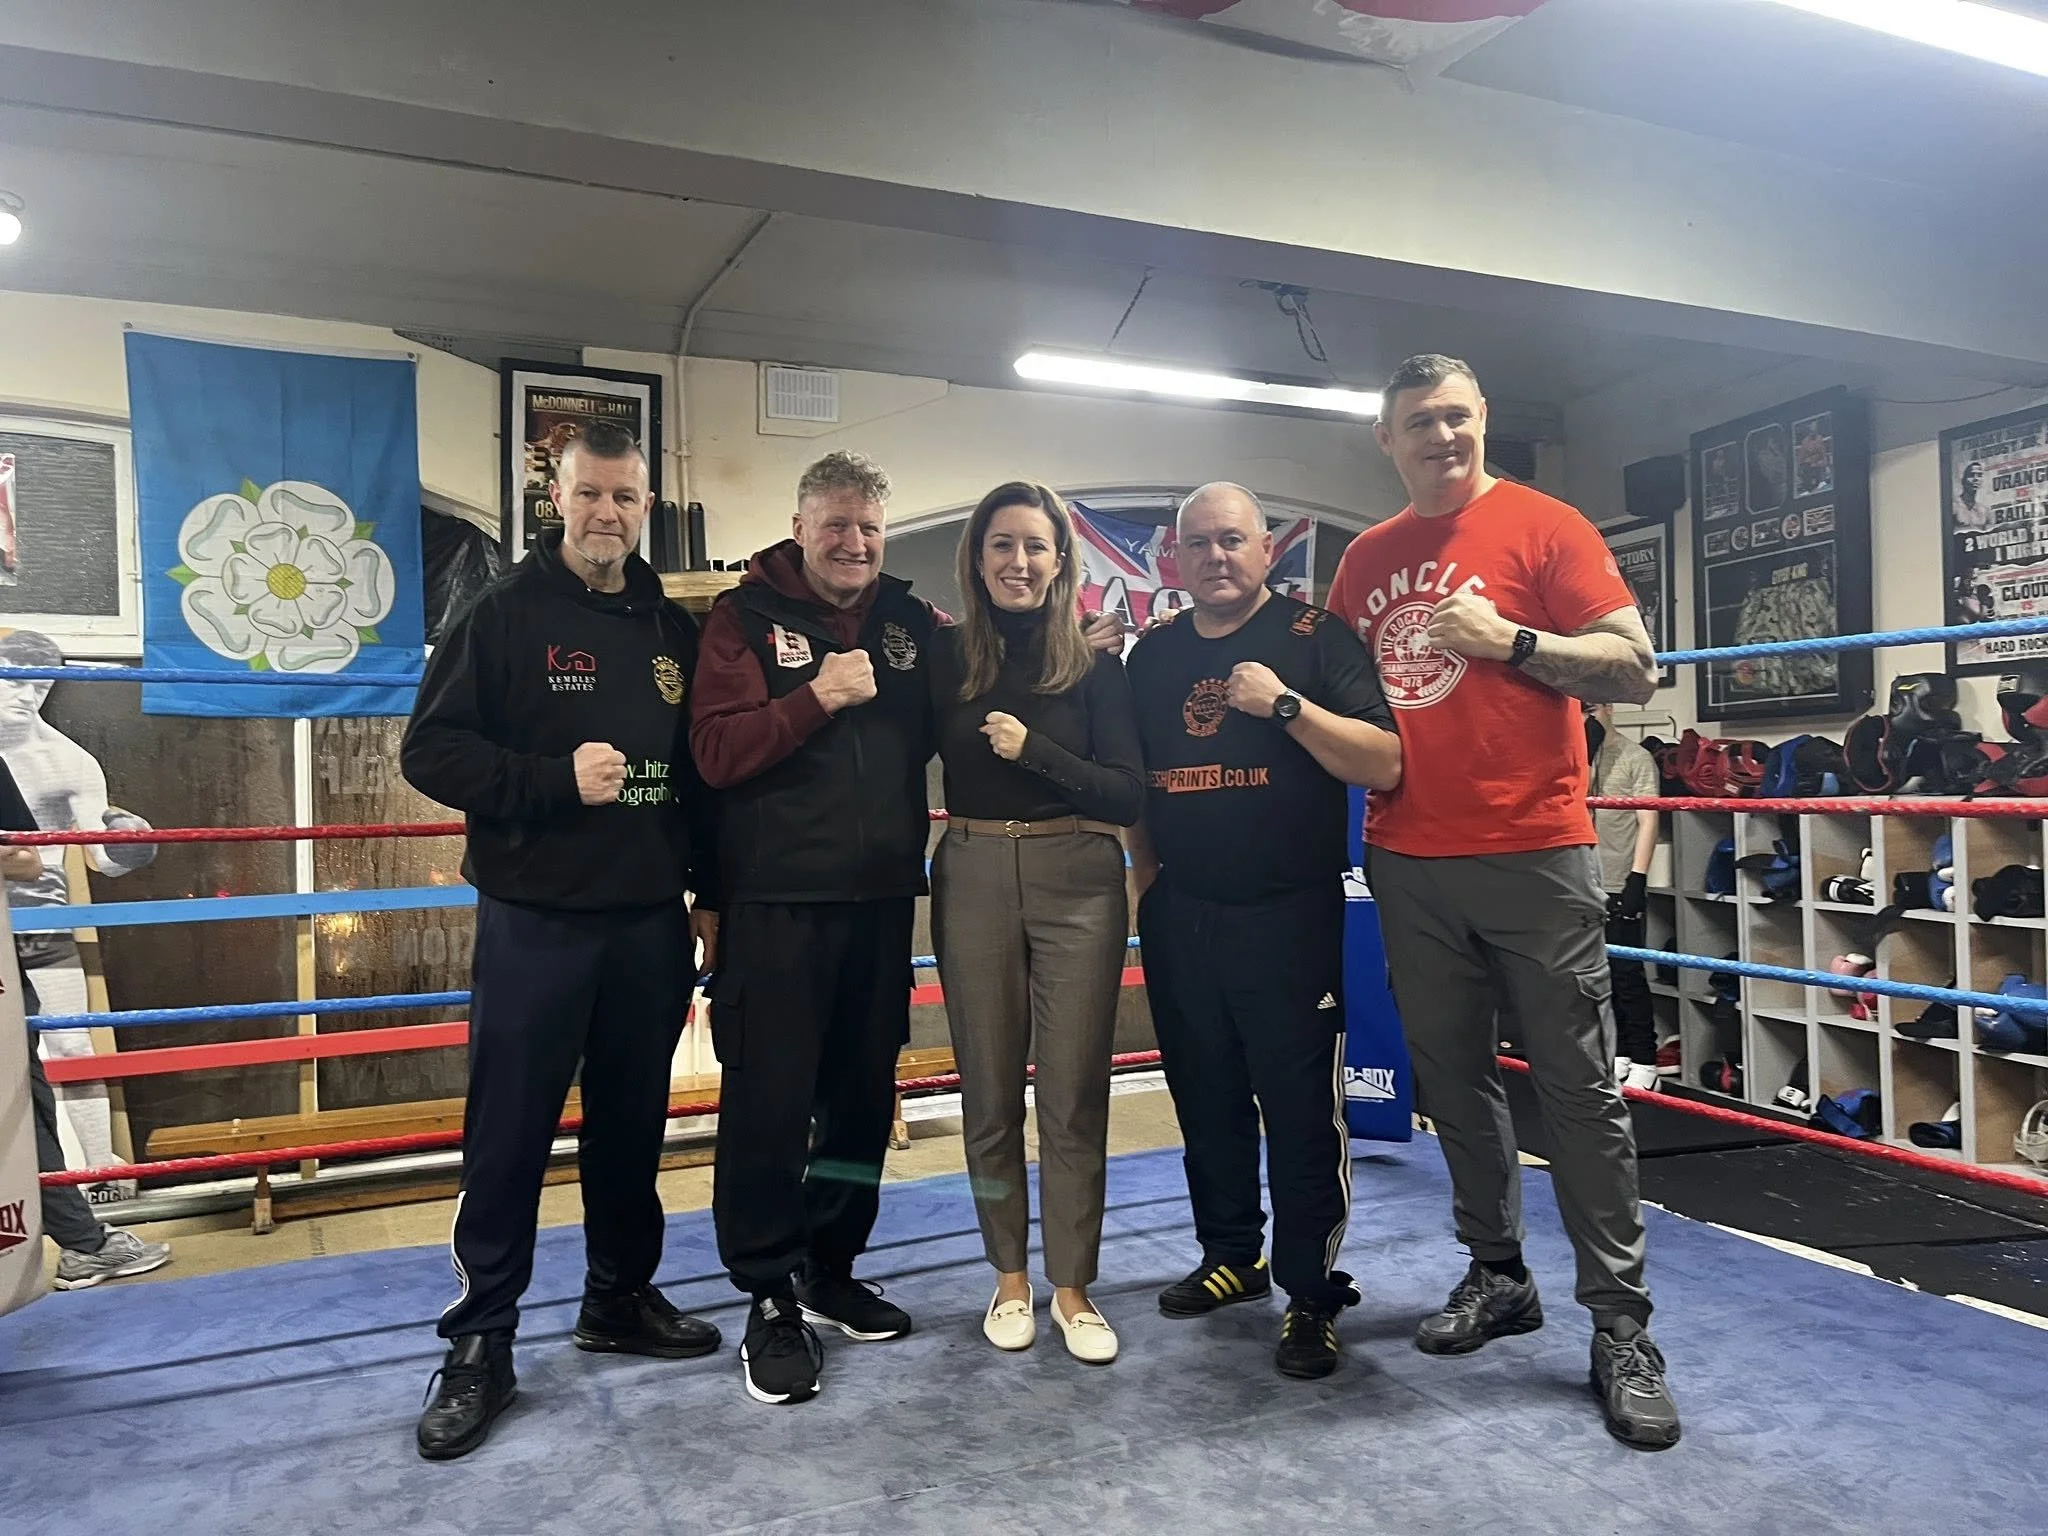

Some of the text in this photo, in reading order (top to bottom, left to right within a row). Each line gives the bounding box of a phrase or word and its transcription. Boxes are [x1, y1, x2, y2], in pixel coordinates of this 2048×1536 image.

[1992, 468, 2048, 492] URANG
[1965, 538, 1974, 552] 2
[1617, 547, 1655, 567] CTORY
[1358, 561, 1487, 644] MONCLE
[548, 676, 597, 684] KEMBLES
[552, 683, 595, 691] ESTATES
[626, 759, 670, 779] v_hitz
[616, 782, 678, 806] ograph
[0, 1200, 28, 1235] OX
